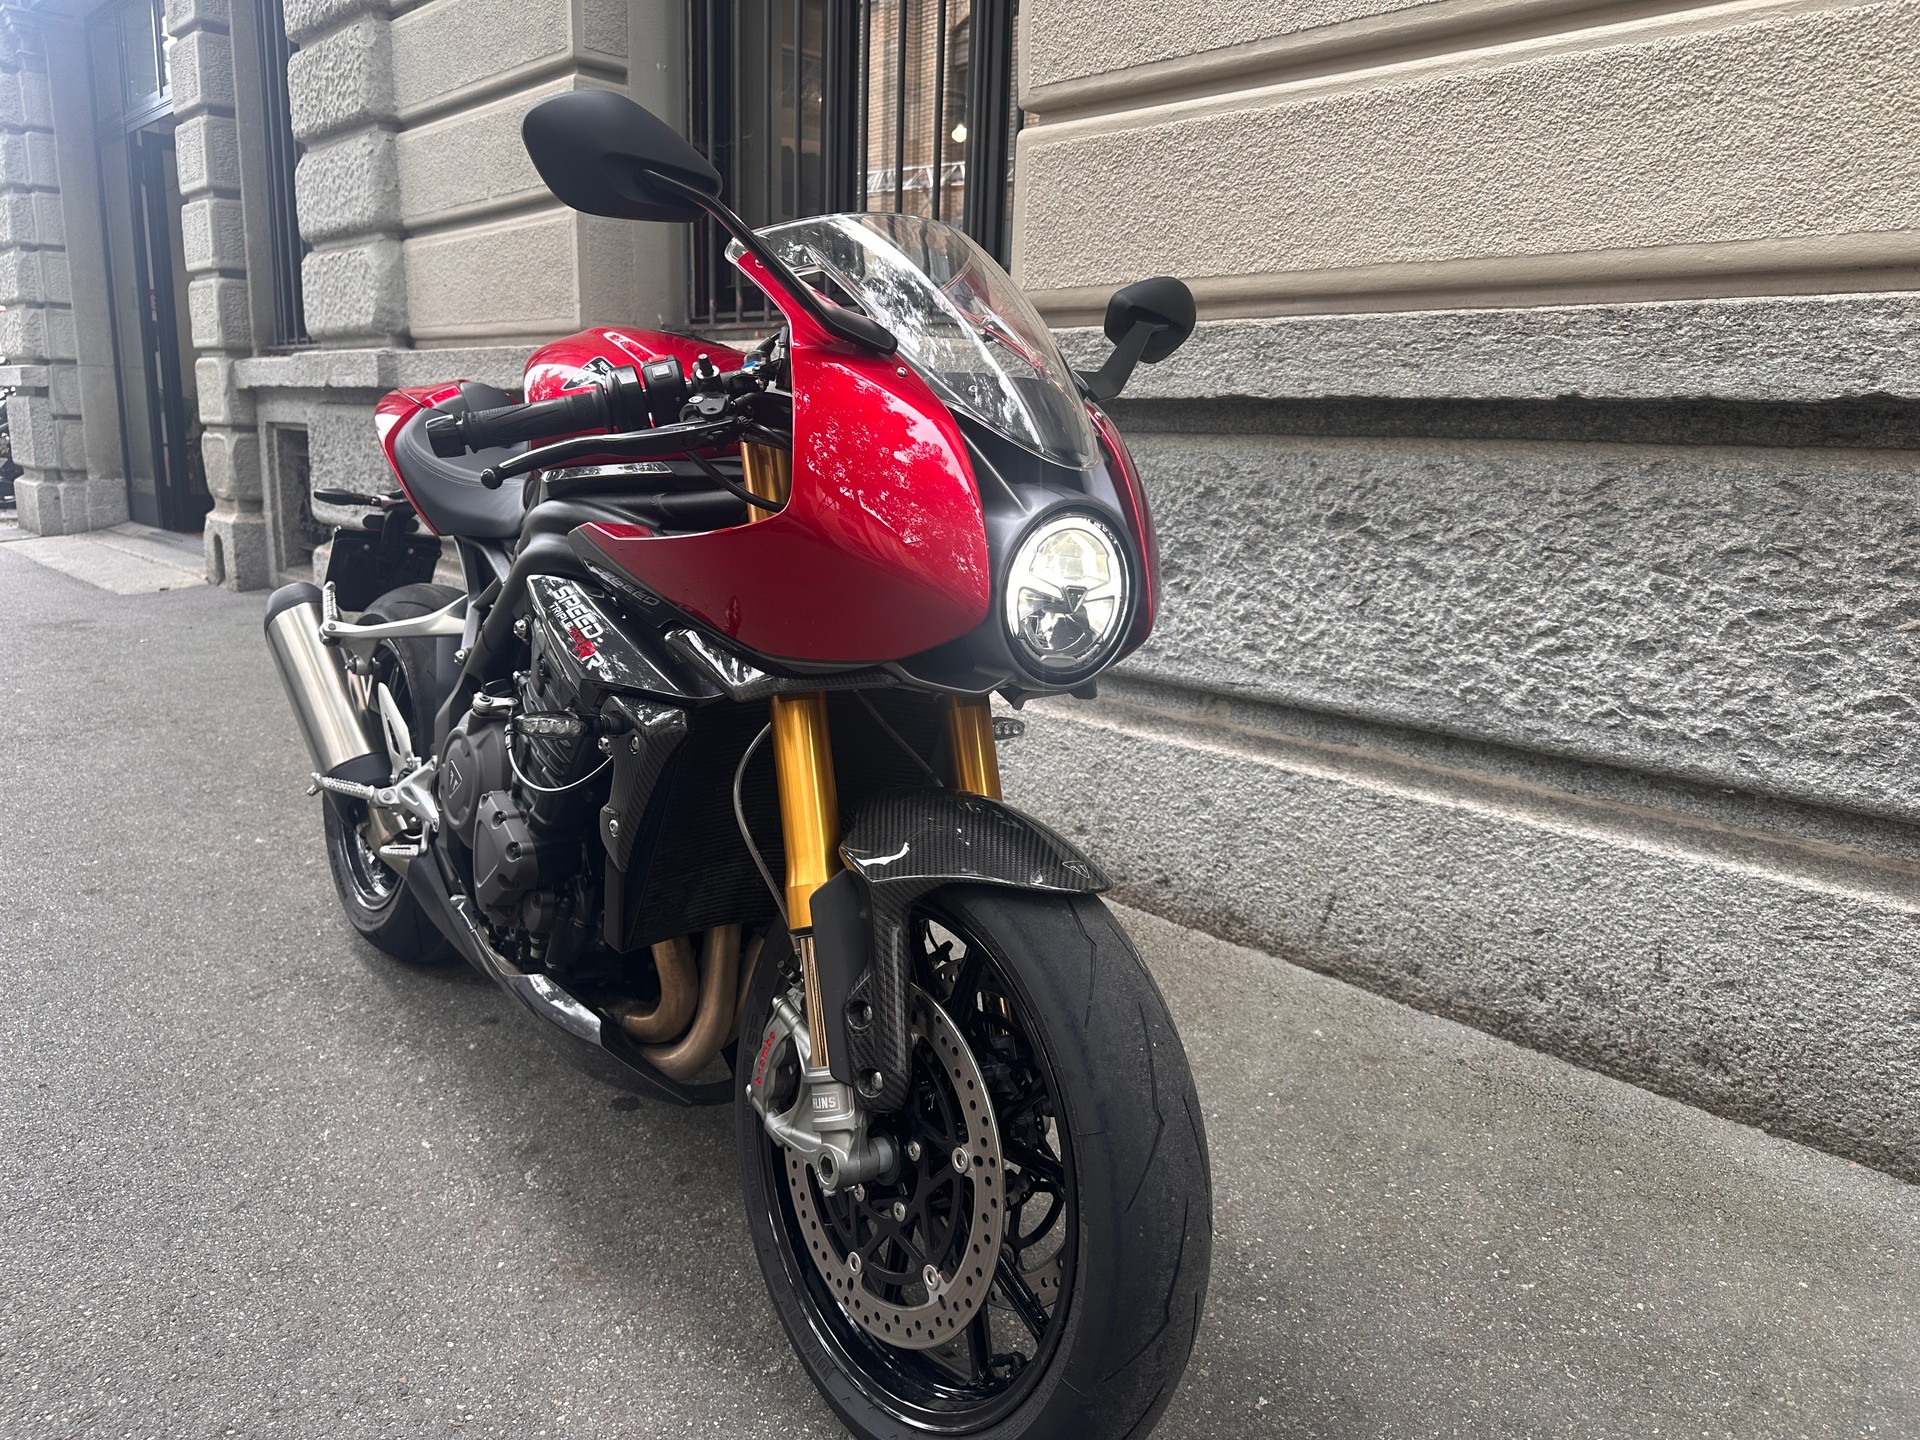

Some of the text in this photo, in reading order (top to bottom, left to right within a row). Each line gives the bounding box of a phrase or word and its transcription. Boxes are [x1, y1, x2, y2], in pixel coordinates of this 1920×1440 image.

[548, 601, 574, 633] TRIPLE
[572, 640, 605, 671] RR
[552, 585, 604, 639] SPEED
[753, 1031, 776, 1087] brembo
